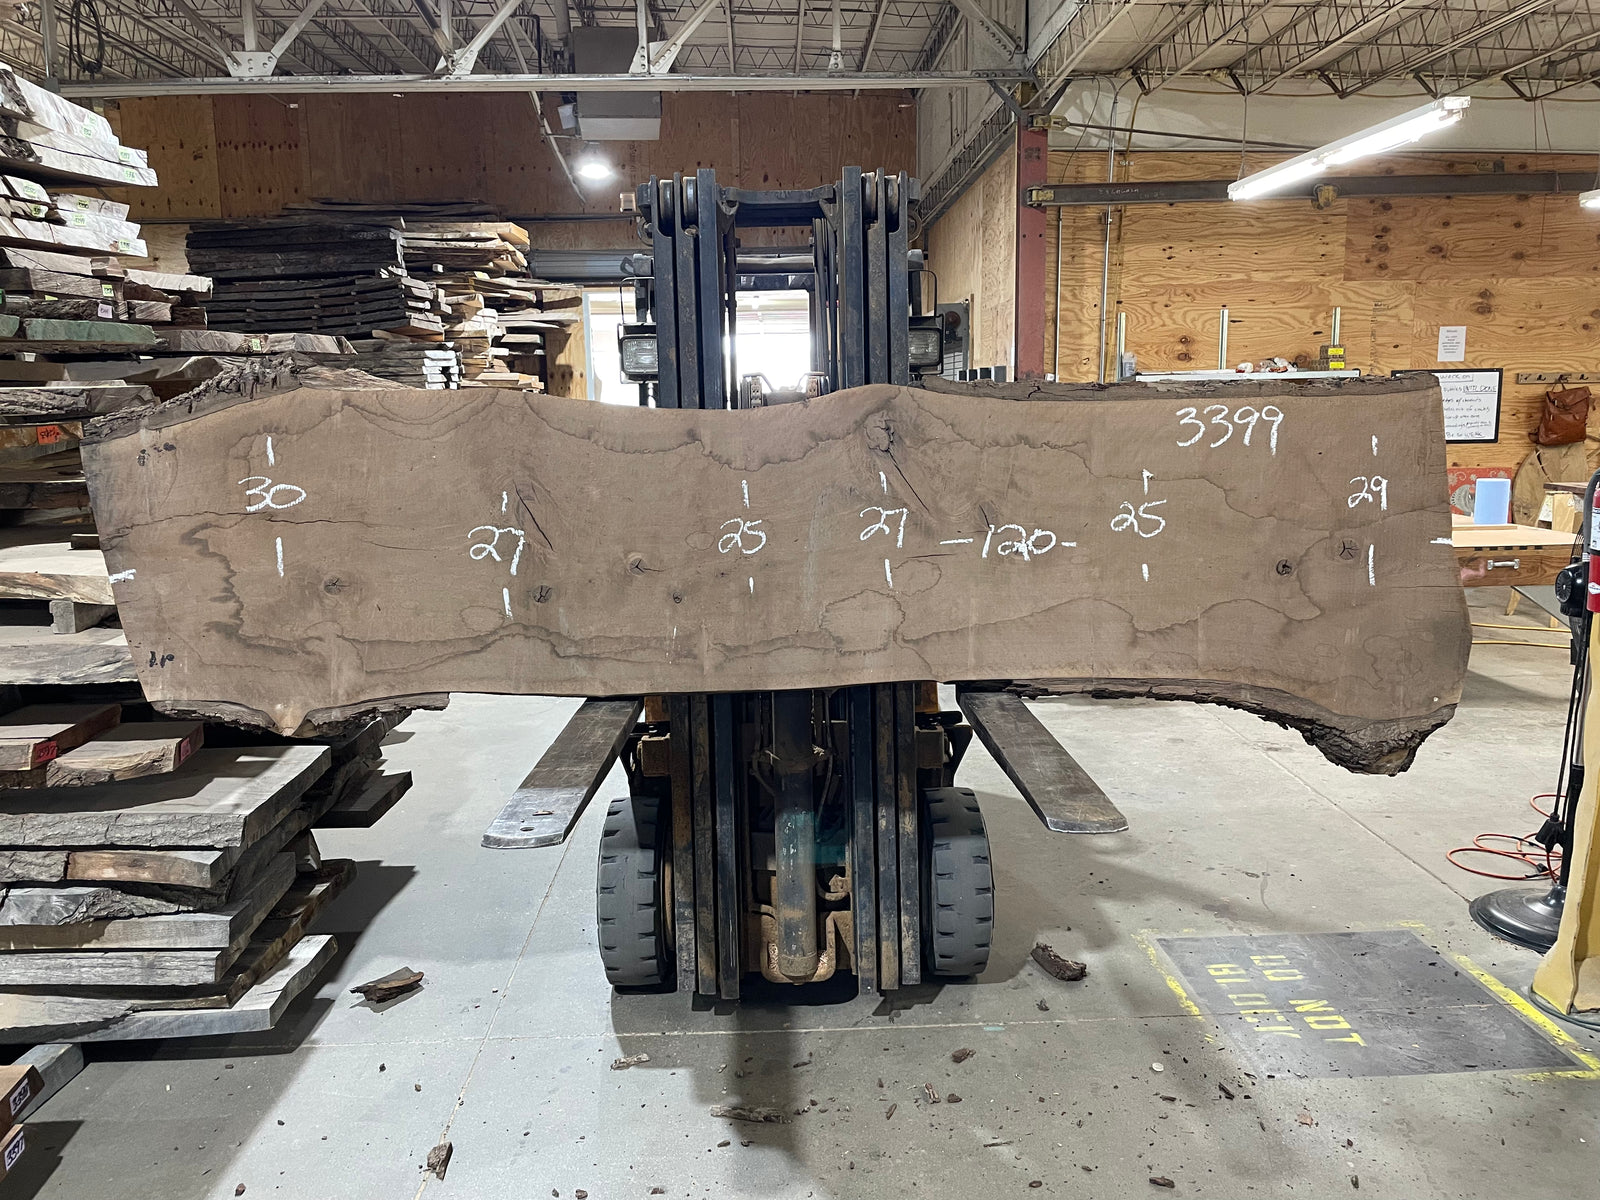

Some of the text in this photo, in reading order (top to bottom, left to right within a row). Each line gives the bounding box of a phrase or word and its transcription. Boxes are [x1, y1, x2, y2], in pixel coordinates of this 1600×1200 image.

[1175, 404, 1285, 456] 3399
[238, 476, 306, 512] 30
[1347, 475, 1389, 511] 29
[718, 517, 767, 555] 25
[860, 506, 909, 548] 27
[1110, 499, 1167, 538] 25
[467, 525, 526, 576] 27
[1250, 954, 1368, 1047] DO NOT
